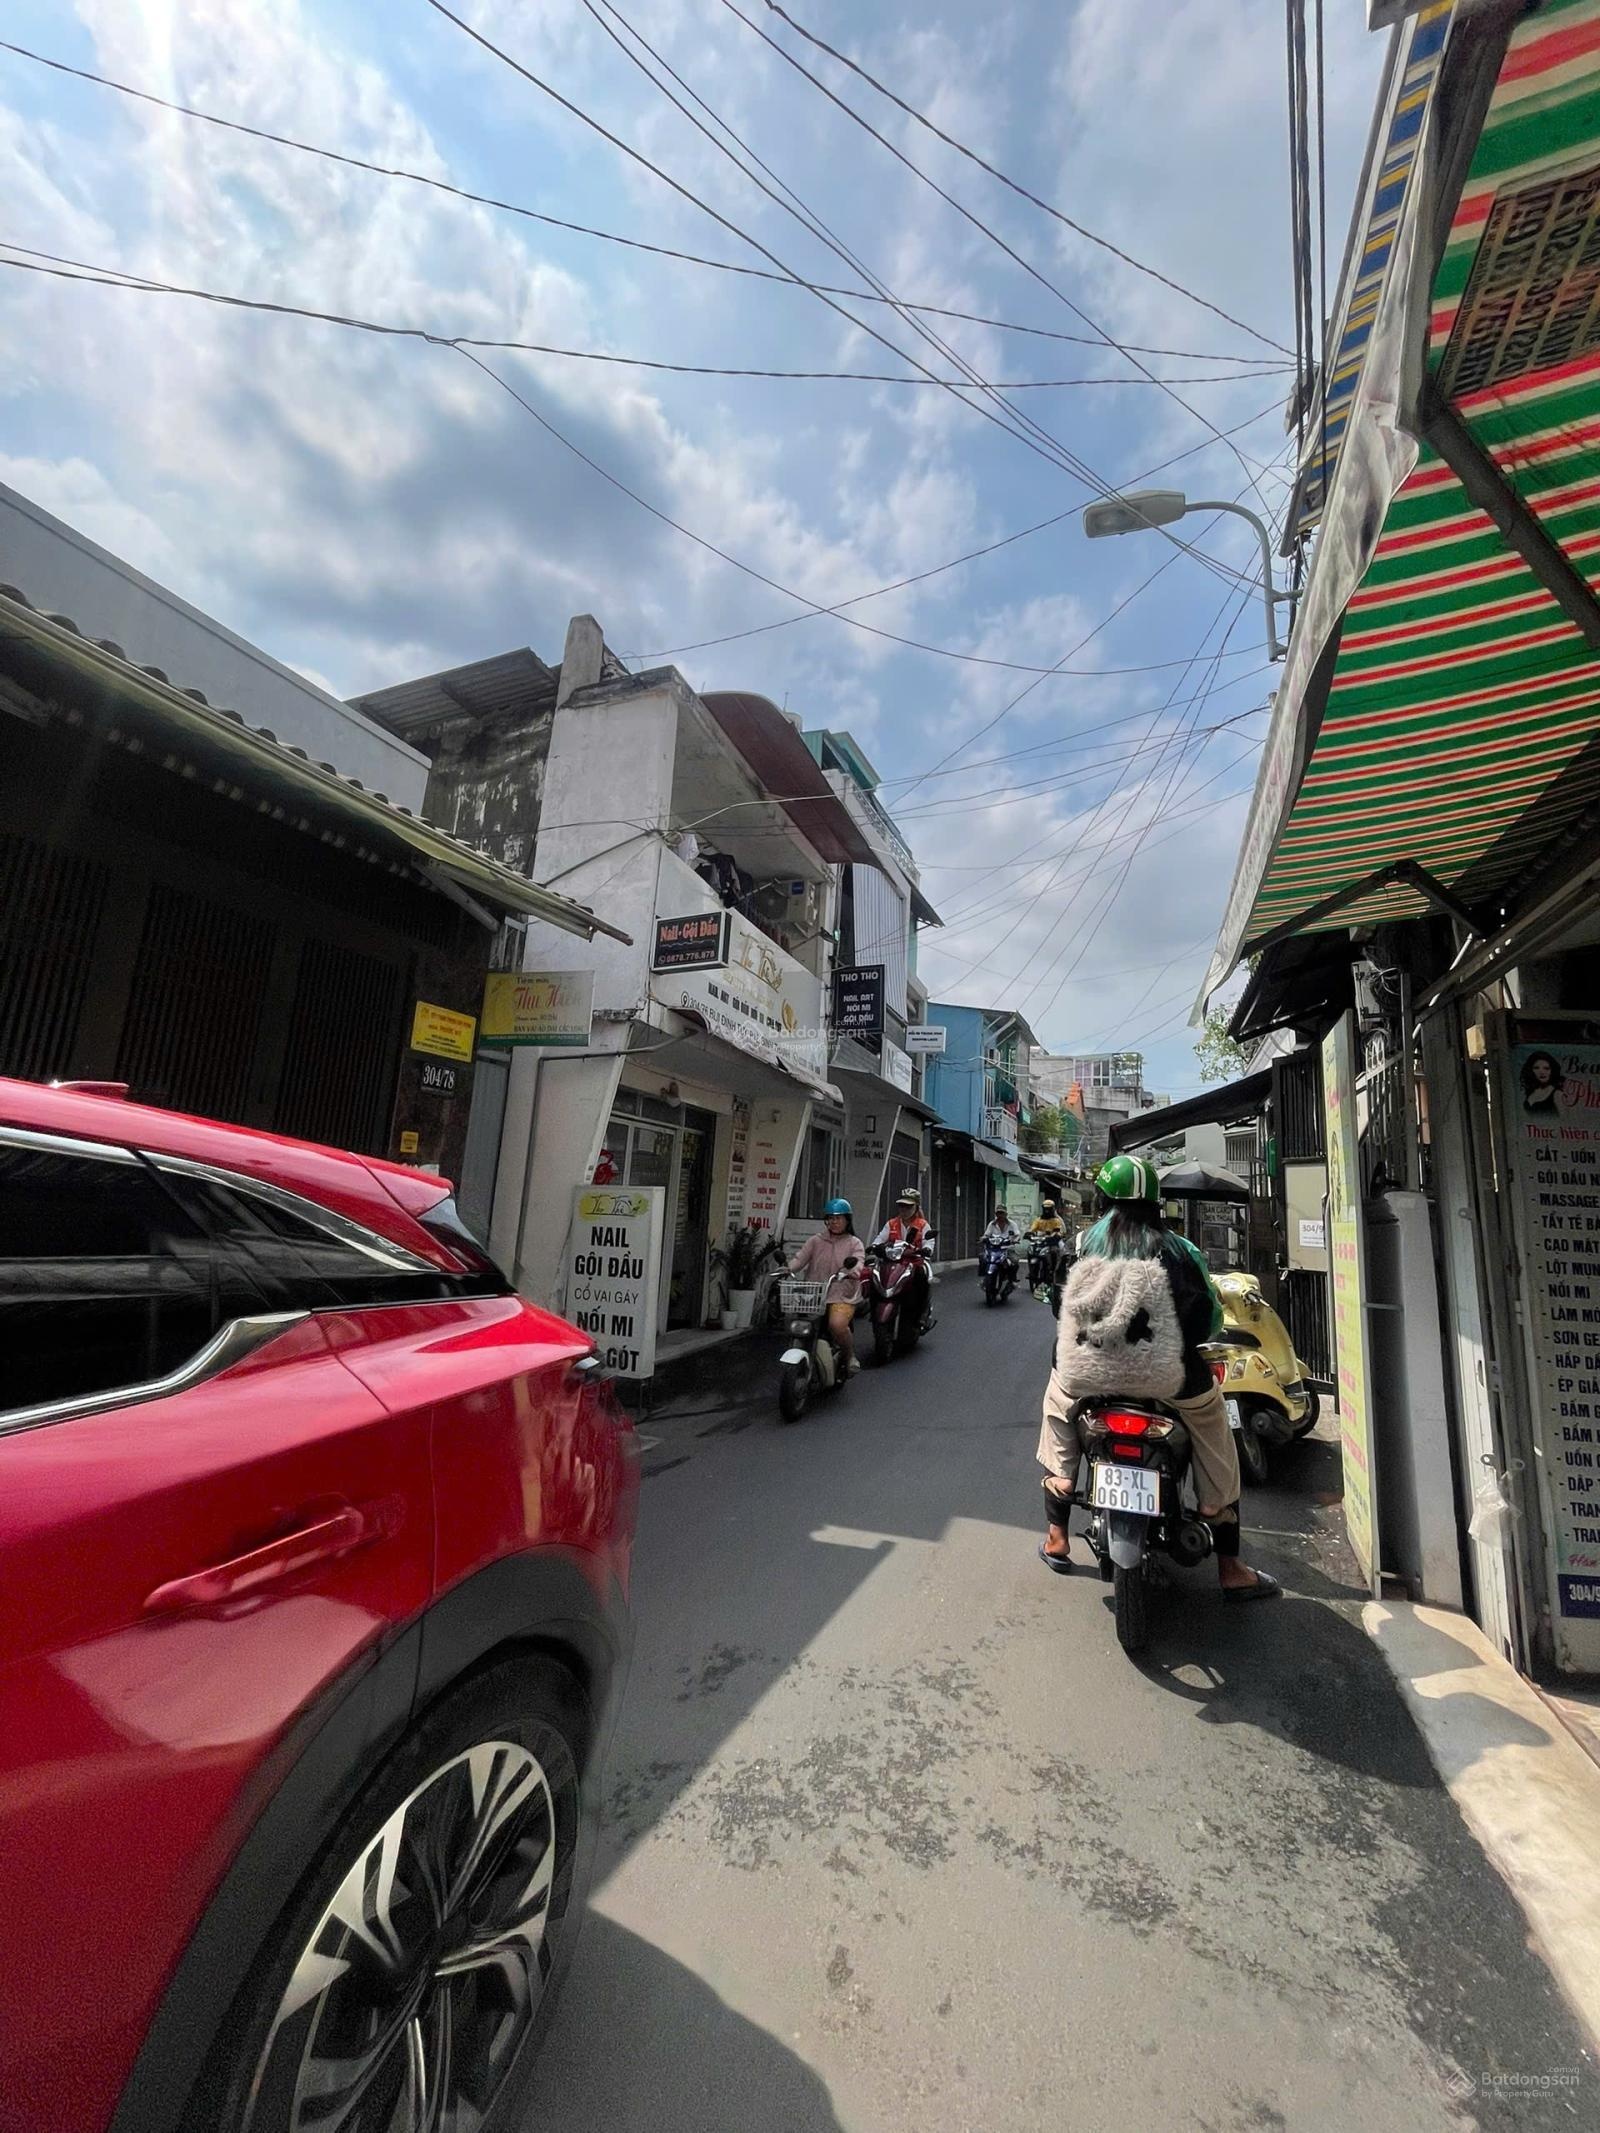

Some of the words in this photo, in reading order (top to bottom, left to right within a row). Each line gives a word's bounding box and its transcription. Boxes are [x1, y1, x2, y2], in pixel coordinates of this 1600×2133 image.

[660, 925, 678, 942] Nail
[423, 1064, 455, 1090] 304/78
[1540, 1193, 1600, 1208] MASSAGE
[747, 1216, 771, 1230] NAIL
[591, 1226, 629, 1248] NAIL
[574, 1251, 603, 1280] GỘI
[608, 1251, 644, 1280] ĐẦU
[594, 1290, 611, 1303] VAI
[614, 1288, 640, 1305] GÁY
[1548, 1280, 1570, 1297] NỐI
[1575, 1285, 1590, 1299] MI
[576, 1306, 605, 1333] NỐI
[611, 1315, 633, 1337] MI
[1551, 1304, 1578, 1321] LÀM
[606, 1345, 640, 1372] GÓT
[1565, 1447, 1592, 1467] UỐN
[1105, 1467, 1148, 1491] 83-XL
[1568, 1474, 1593, 1495] DẬP
[1097, 1487, 1155, 1512] 060.10
